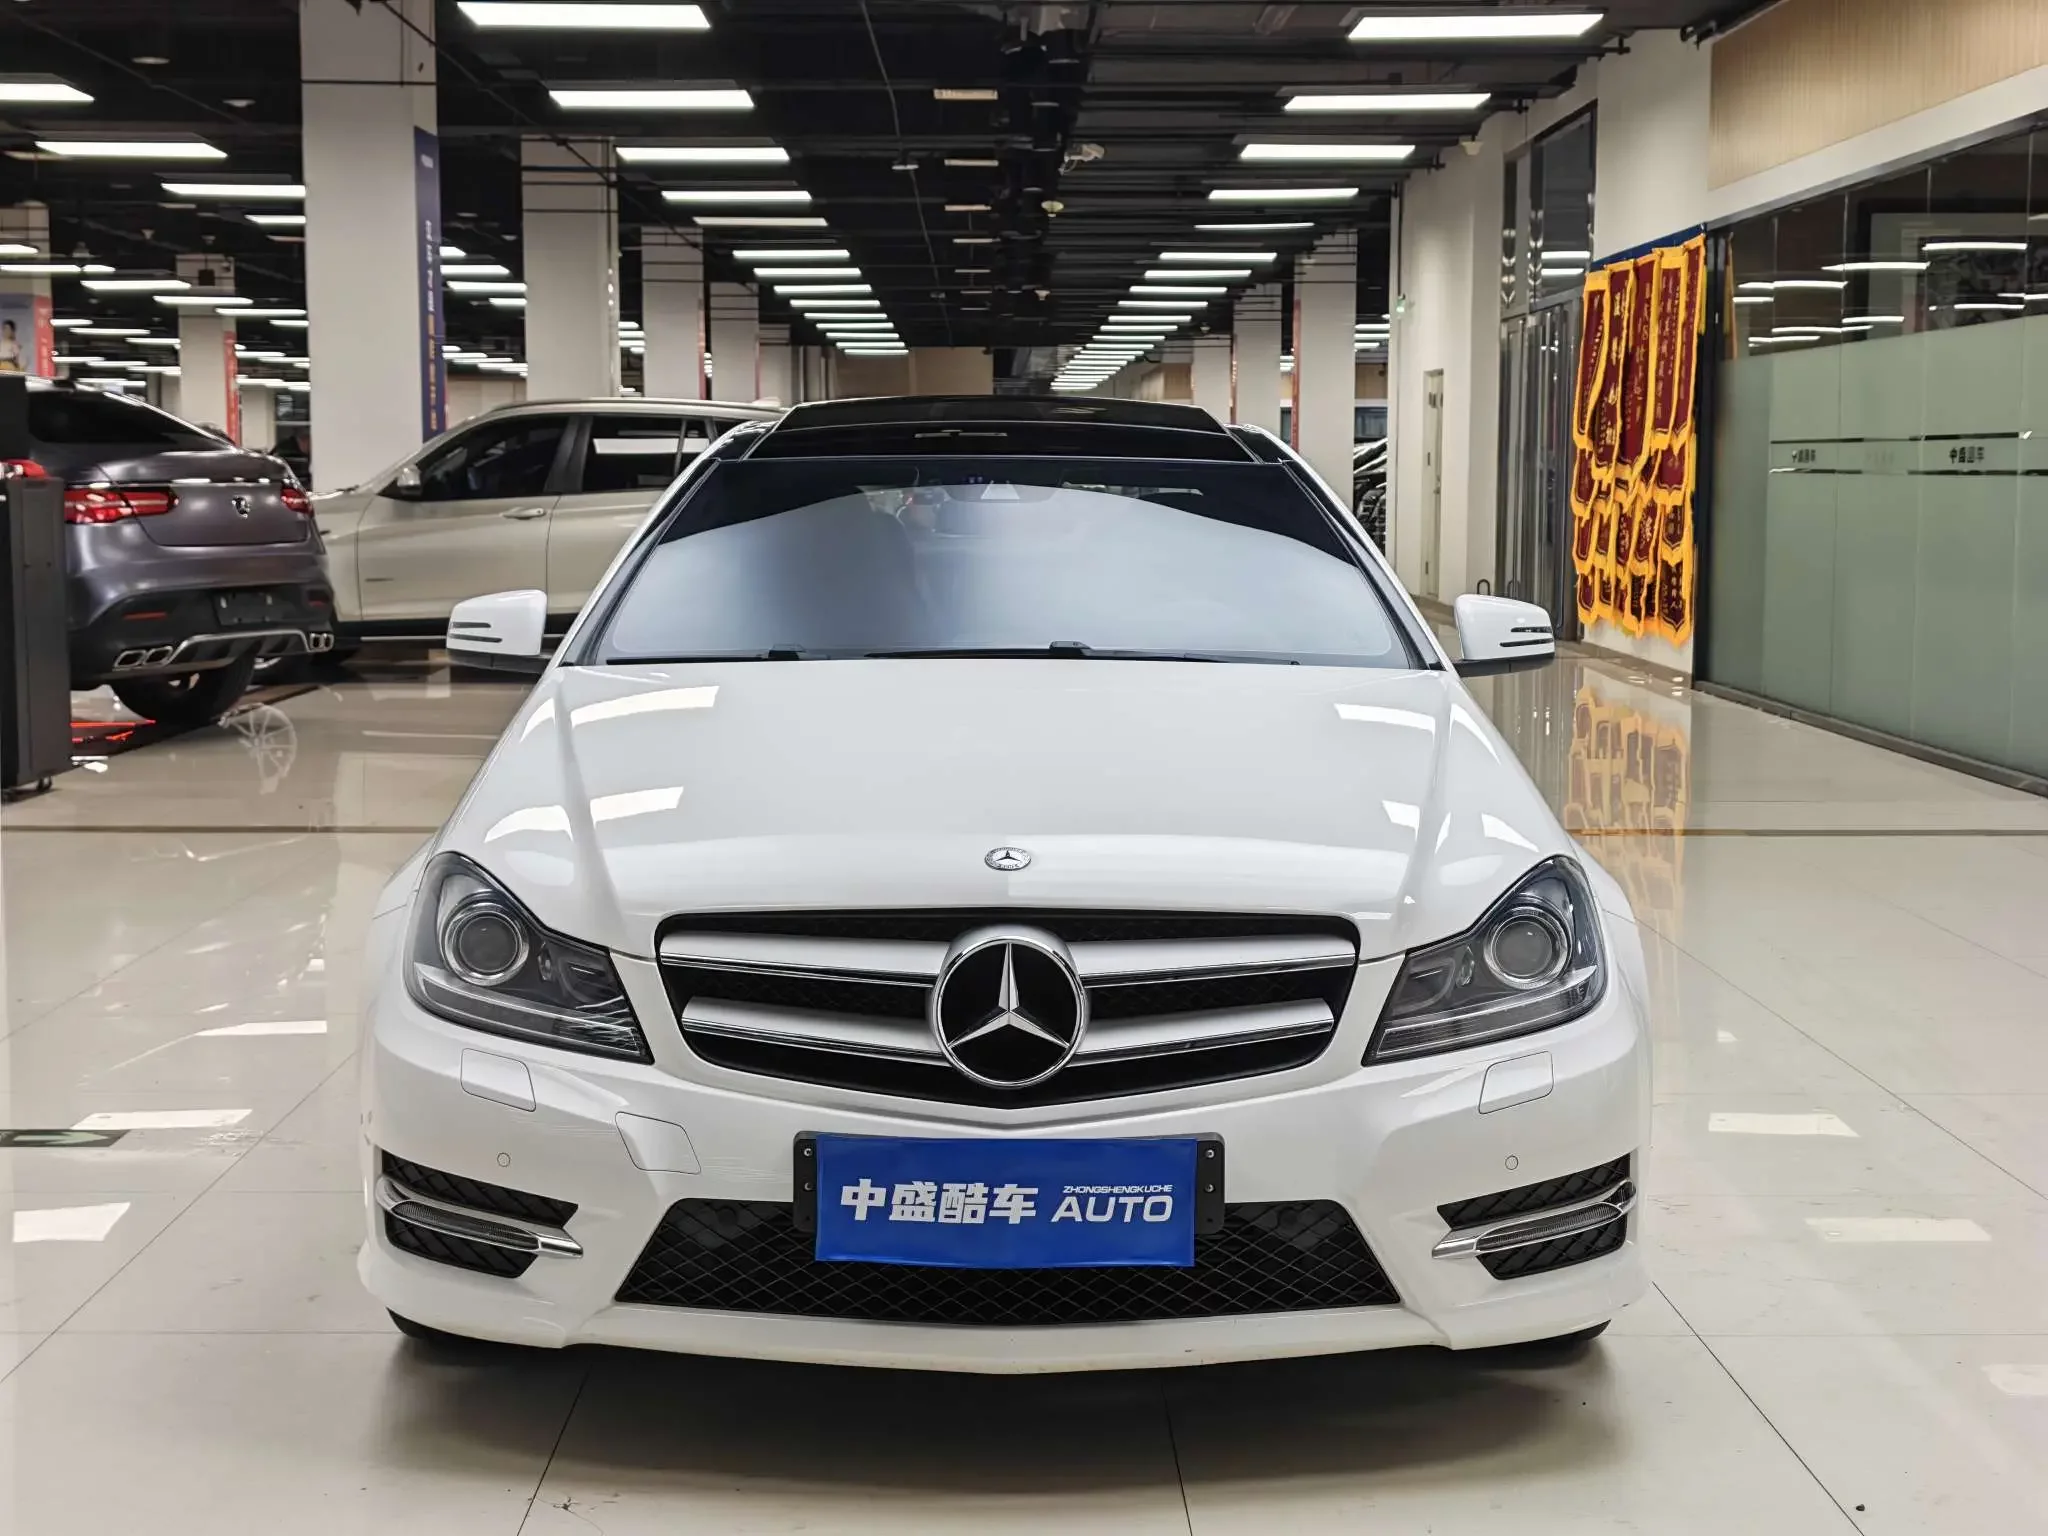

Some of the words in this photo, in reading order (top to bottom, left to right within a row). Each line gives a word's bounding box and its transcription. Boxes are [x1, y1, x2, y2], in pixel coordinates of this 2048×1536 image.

[840, 1178, 1039, 1224] 中盛酷车
[1062, 1184, 1173, 1194] ZHONGSHENGKUCHE
[1050, 1195, 1173, 1223] AUTO
